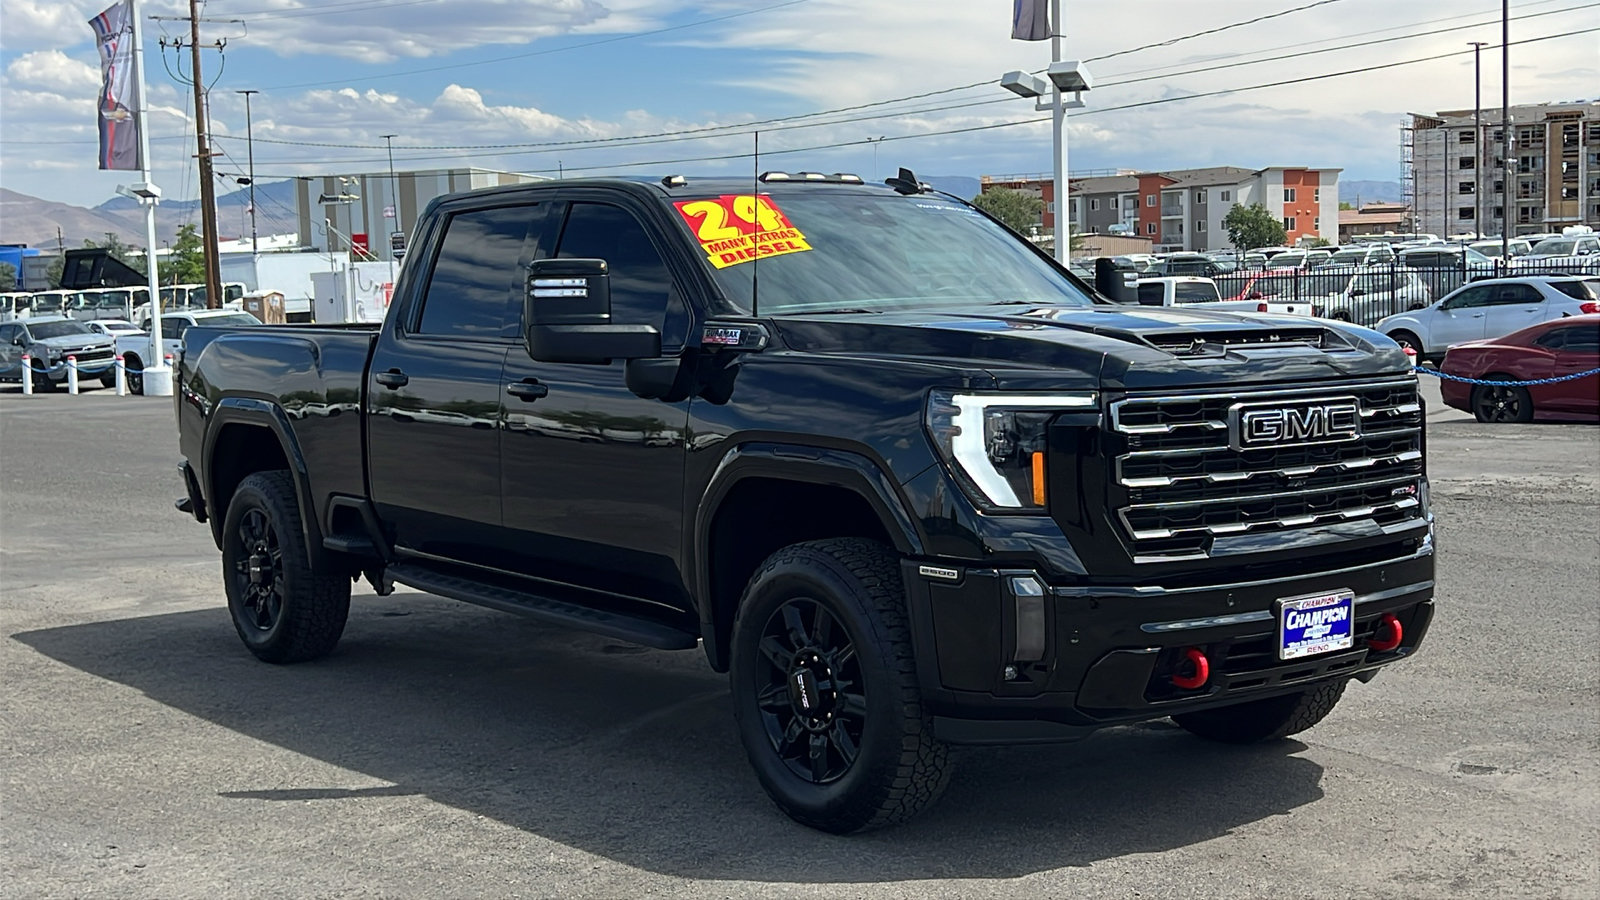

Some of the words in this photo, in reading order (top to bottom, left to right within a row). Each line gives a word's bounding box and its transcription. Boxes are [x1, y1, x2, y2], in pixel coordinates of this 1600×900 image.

[681, 195, 785, 241] 24
[708, 236, 748, 254] MANY
[749, 229, 798, 244] EXTRAS
[720, 240, 803, 264] DIESEL
[1242, 404, 1357, 443] GMC
[1302, 596, 1336, 608] CHAMPION
[1286, 606, 1349, 630] CHAMPION
[1307, 644, 1330, 653] RENO
